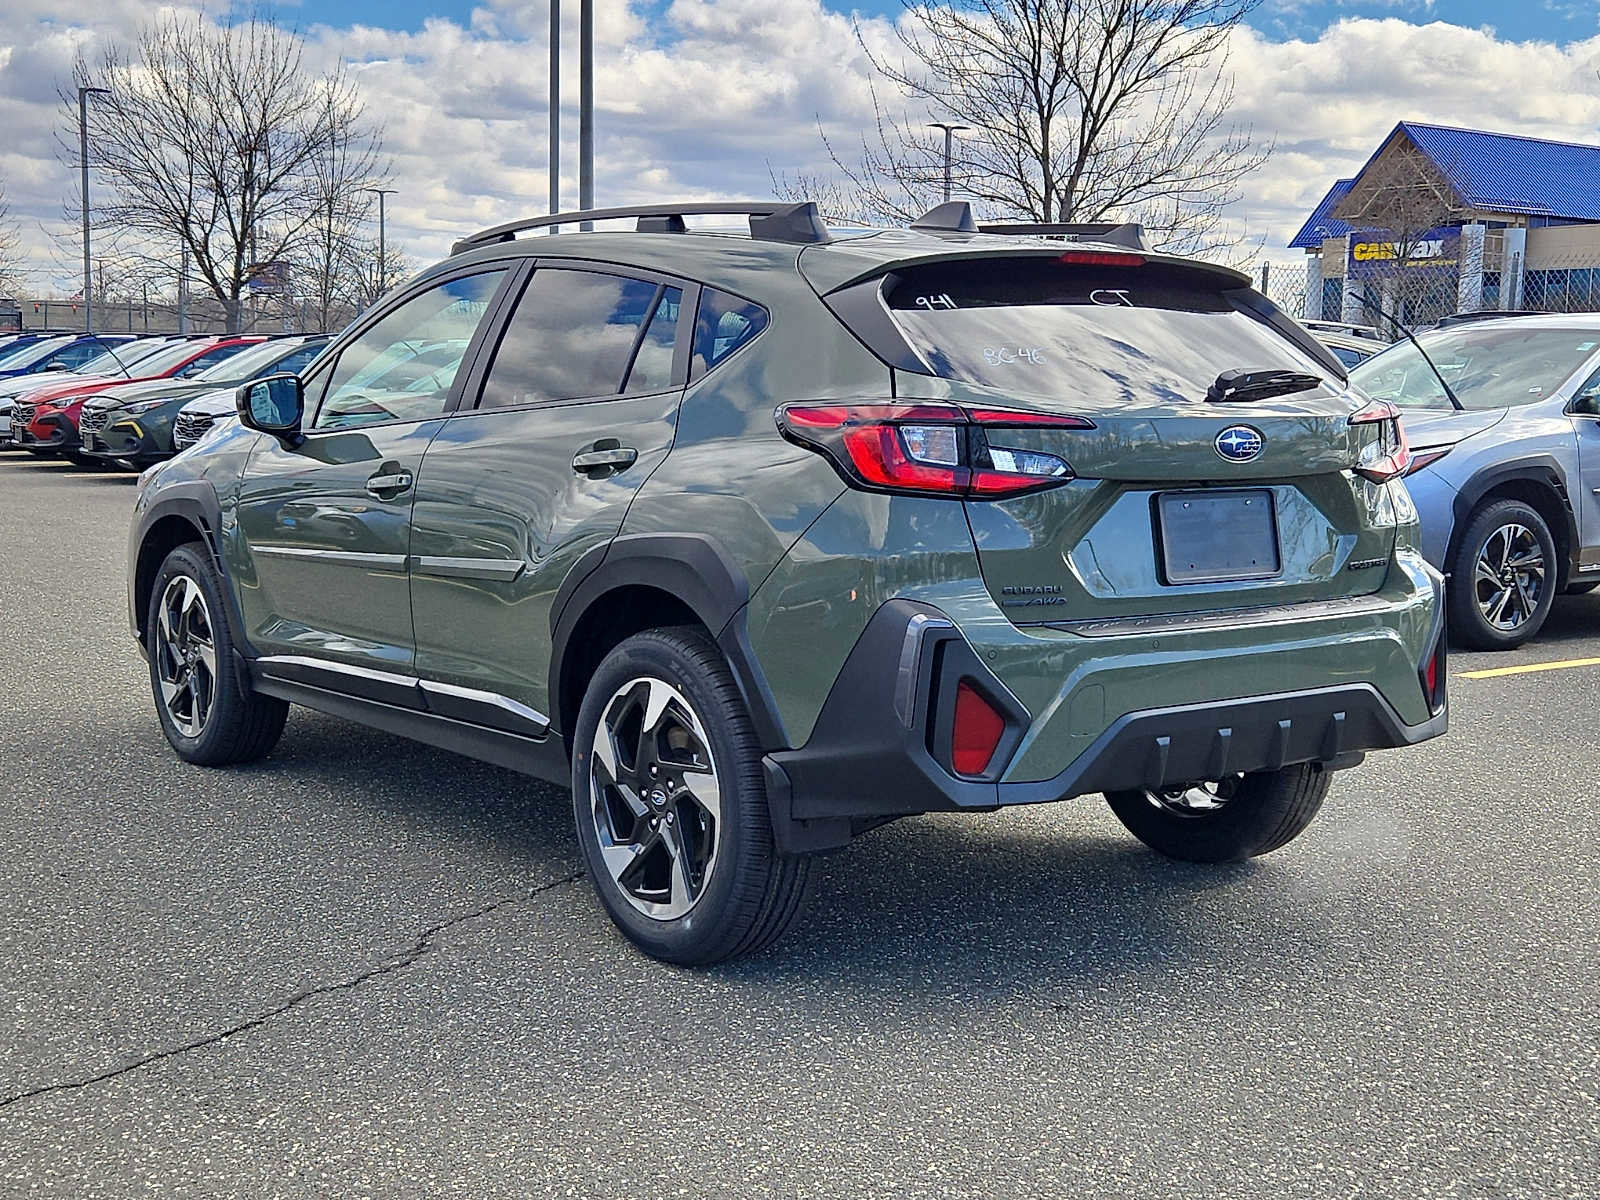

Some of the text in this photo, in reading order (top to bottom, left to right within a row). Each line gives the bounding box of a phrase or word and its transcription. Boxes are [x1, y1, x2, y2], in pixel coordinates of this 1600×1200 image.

[915, 293, 958, 311] 941
[1089, 289, 1134, 307] CT
[1001, 585, 1063, 595] SUBARU
